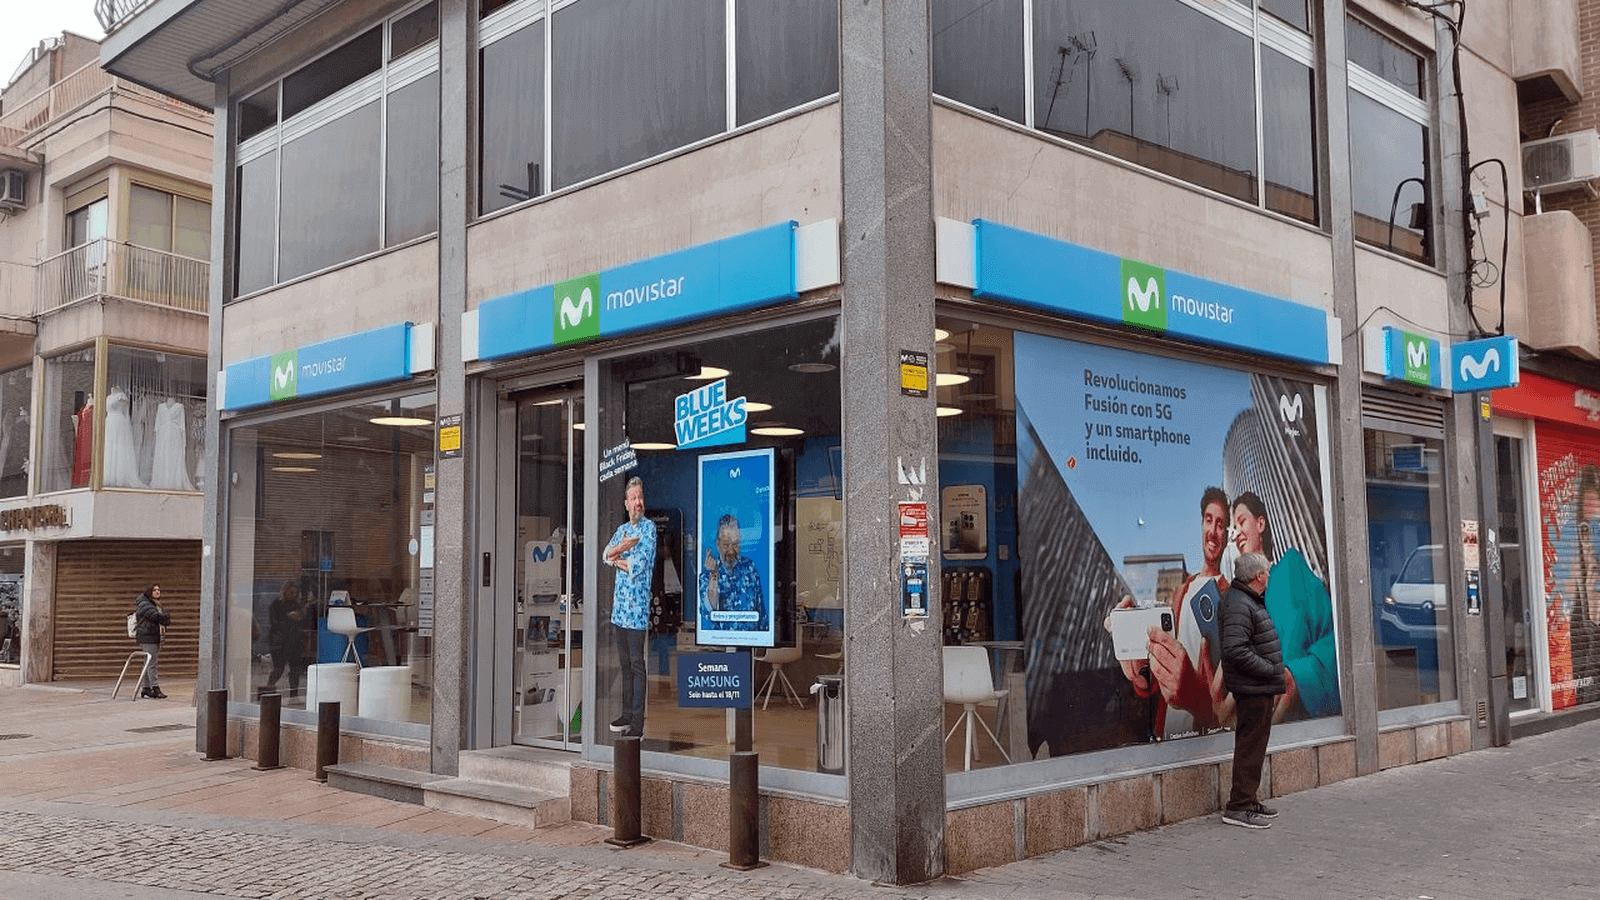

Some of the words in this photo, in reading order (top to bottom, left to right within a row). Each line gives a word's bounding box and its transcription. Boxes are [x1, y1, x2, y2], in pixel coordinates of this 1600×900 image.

[606, 276, 684, 310] movistar
[1171, 294, 1234, 324] movistar
[301, 356, 346, 377] movistar
[1084, 368, 1186, 400] Revolucionamos
[677, 381, 725, 421] BLUE
[1084, 393, 1128, 415] Fusión
[1130, 404, 1153, 418] con
[1155, 402, 1173, 421] 5G
[676, 398, 746, 443] WEEKS
[1084, 421, 1094, 440] y
[1095, 423, 1113, 437] un
[1115, 425, 1191, 447] smartphone
[1085, 440, 1142, 464] incluido.
[698, 662, 728, 672] Semana
[688, 675, 739, 687] SAMSUNG
[688, 690, 702, 699] Solo
